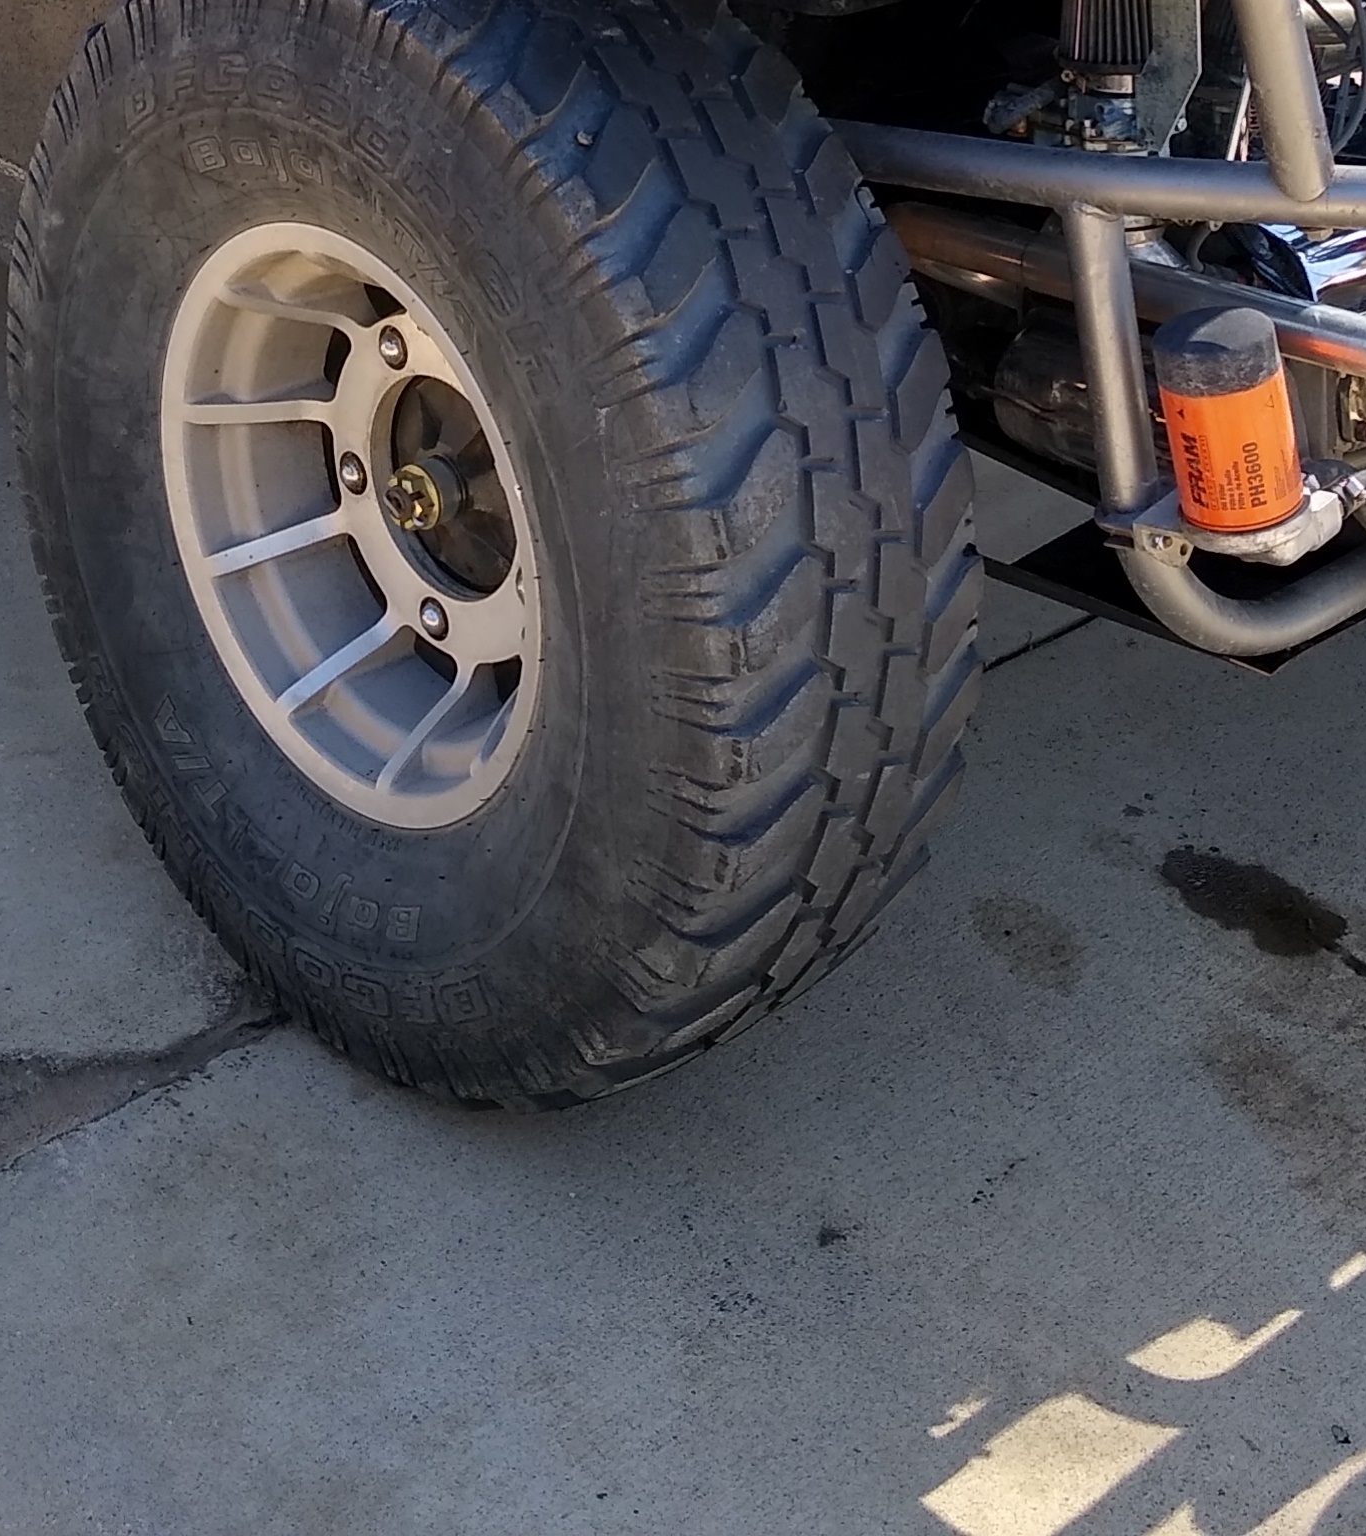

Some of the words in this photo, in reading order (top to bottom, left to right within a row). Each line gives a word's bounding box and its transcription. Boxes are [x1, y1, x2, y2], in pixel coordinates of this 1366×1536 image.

[187, 135, 325, 186] Baja
[1181, 432, 1210, 510] FRAM
[1241, 441, 1268, 508] PH3600
[284, 861, 423, 945] Baja
